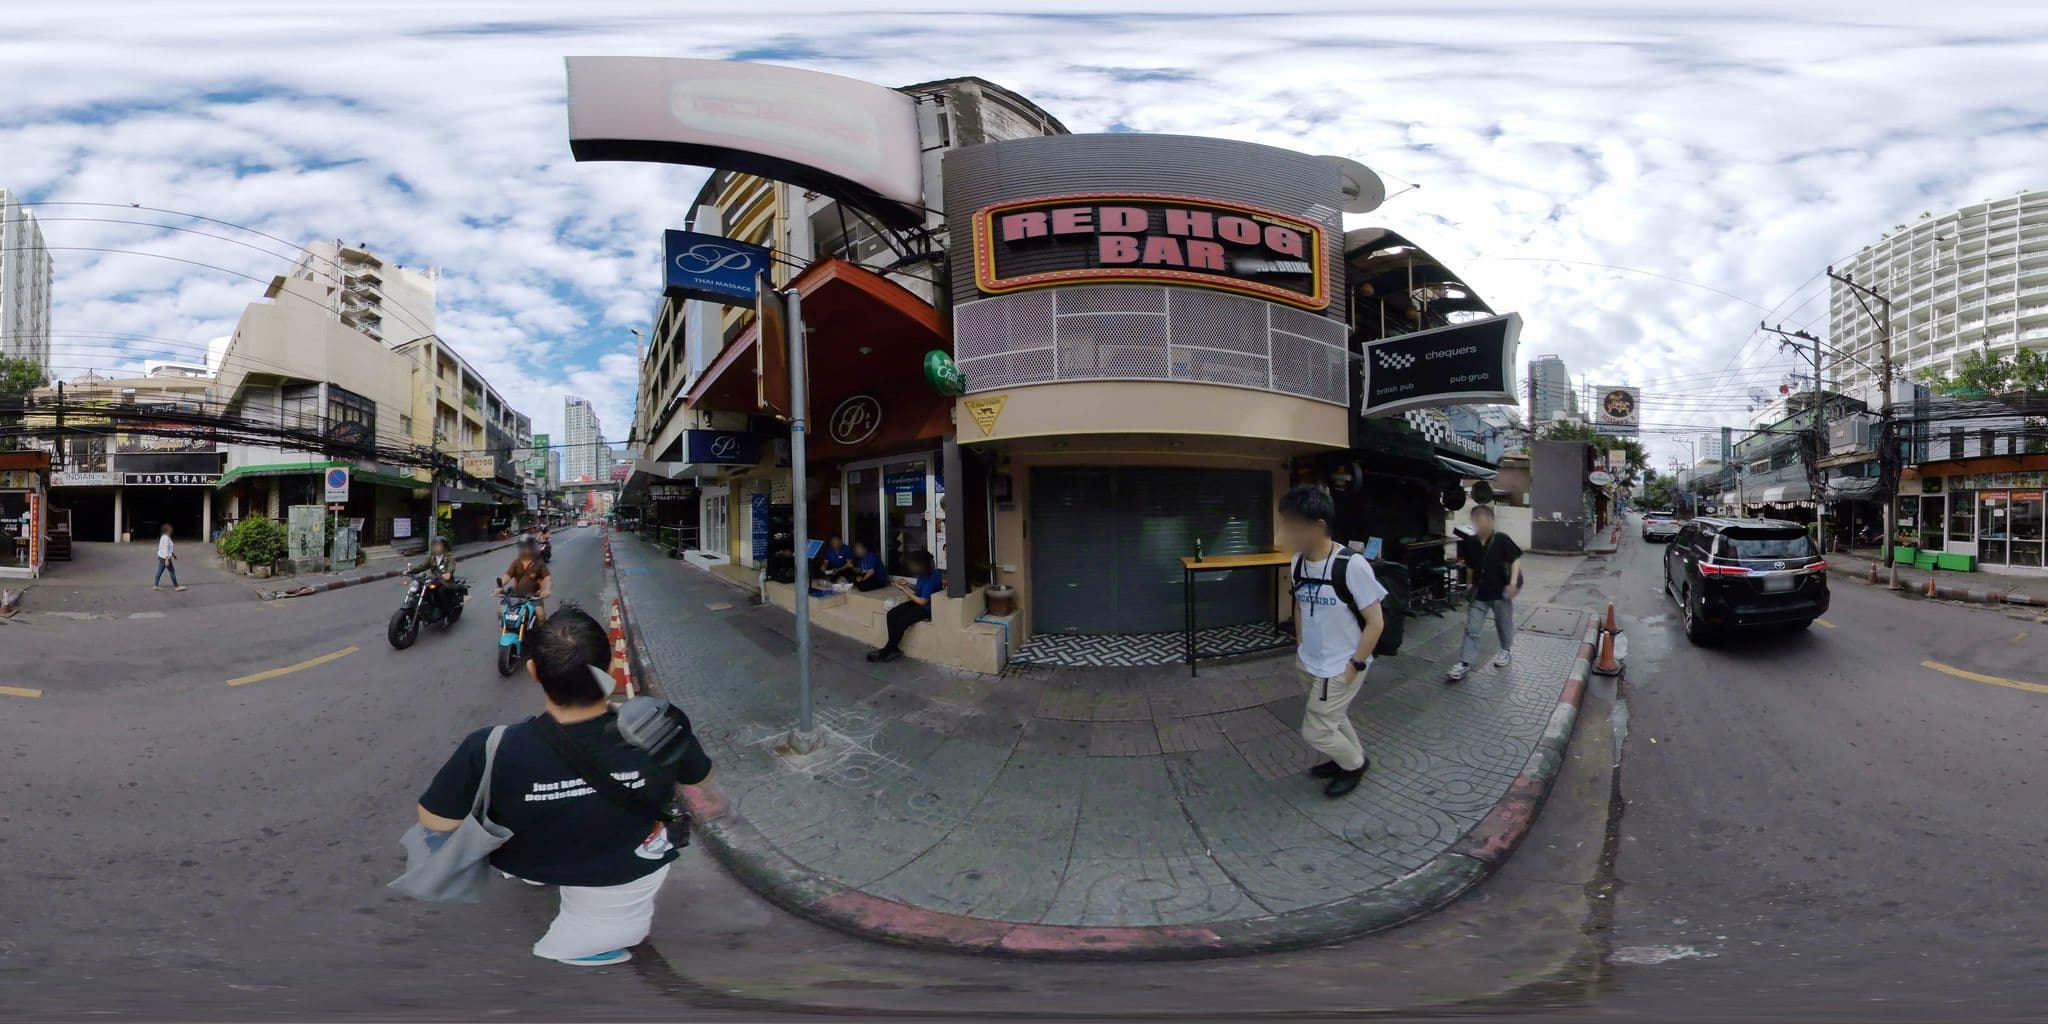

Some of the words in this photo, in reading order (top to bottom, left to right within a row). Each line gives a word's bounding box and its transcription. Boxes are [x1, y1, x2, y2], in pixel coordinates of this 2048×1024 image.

[1002, 206, 1149, 243] RED
[1165, 208, 1303, 259] HOG
[675, 243, 755, 274] P
[1099, 235, 1226, 271] BAR
[1276, 260, 1313, 273] DRINK
[693, 277, 714, 285] THAI
[715, 281, 752, 292] MASSAGE
[1425, 345, 1477, 360] chequers
[1450, 375, 1467, 384] pub
[1468, 372, 1489, 382] grub
[1376, 385, 1398, 396] british
[1400, 383, 1415, 393] pub
[1445, 428, 1485, 454] chequers
[65, 473, 95, 481] INDIAN
[533, 782, 560, 792] Just
[560, 778, 587, 789] kee
